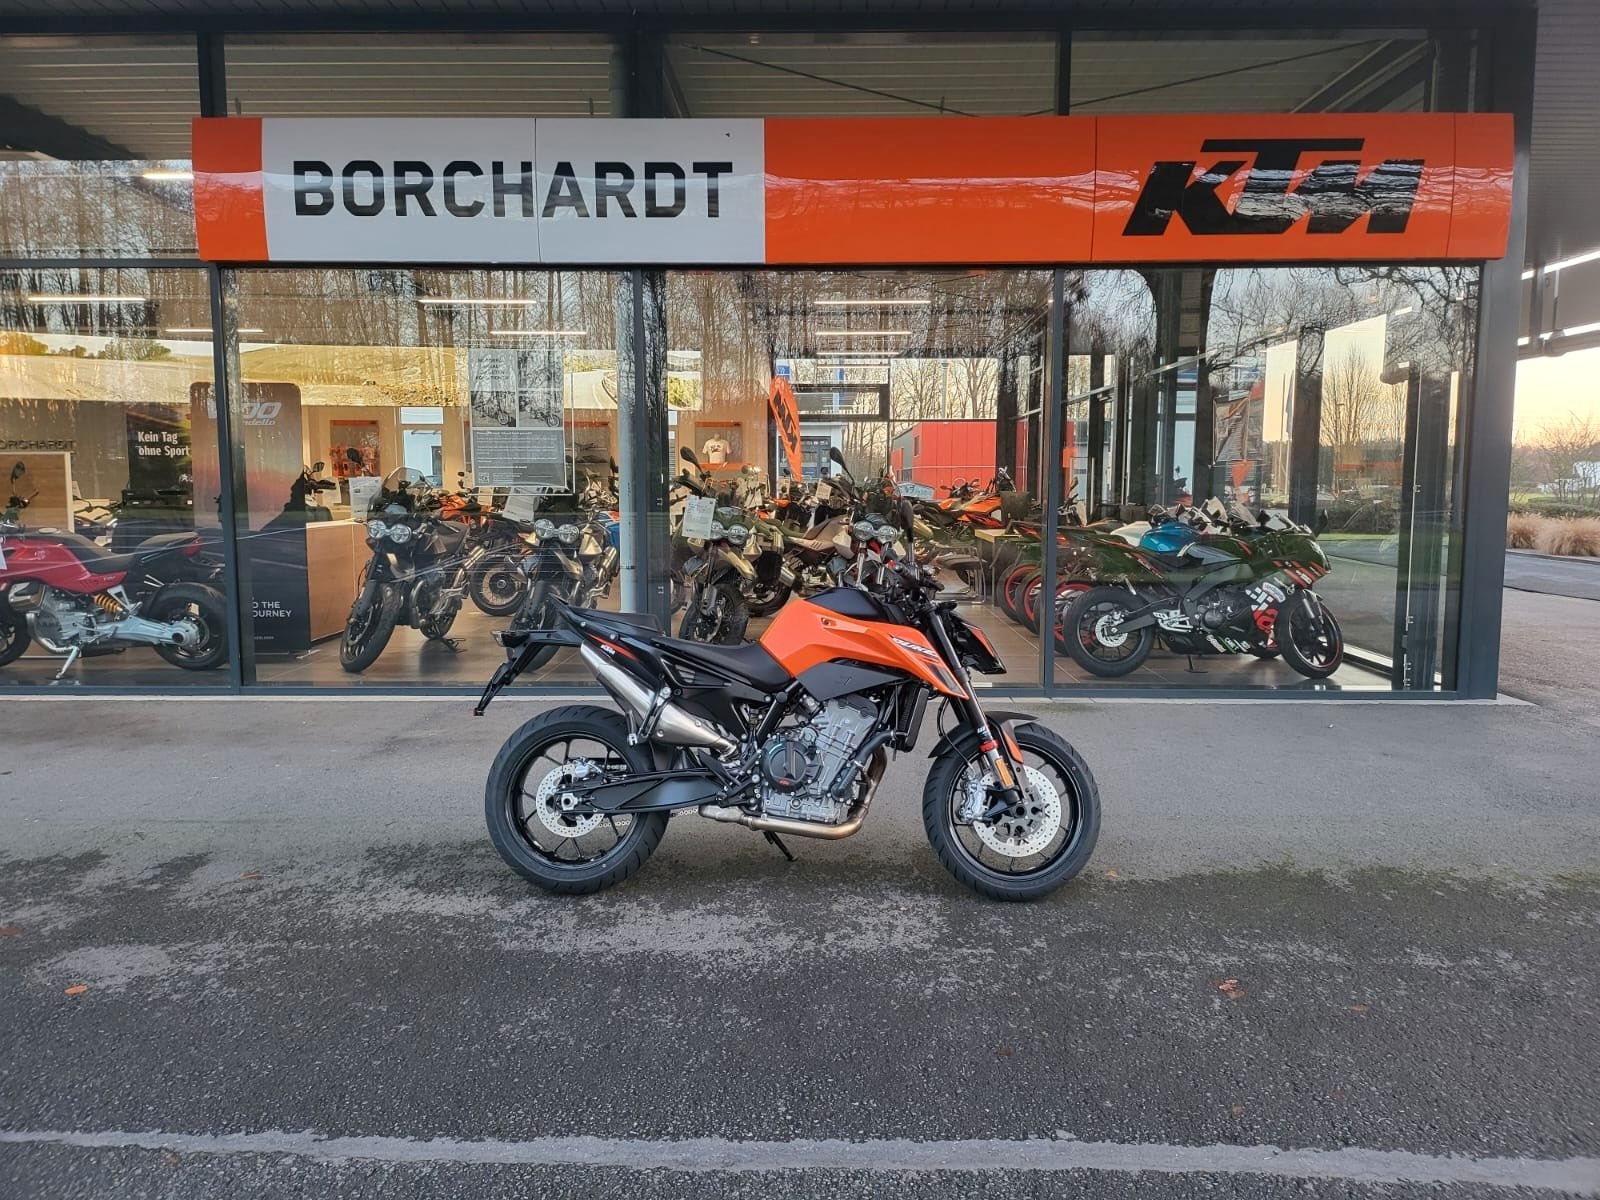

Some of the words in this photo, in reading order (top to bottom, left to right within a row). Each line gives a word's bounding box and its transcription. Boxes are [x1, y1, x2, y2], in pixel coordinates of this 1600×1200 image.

[292, 159, 733, 218] BORCHARDT
[1122, 138, 1425, 235] KTM
[137, 431, 159, 443] Kein
[162, 431, 178, 445] Tag
[138, 445, 162, 456] ohne
[164, 445, 191, 458] Sport
[261, 601, 281, 609] THE
